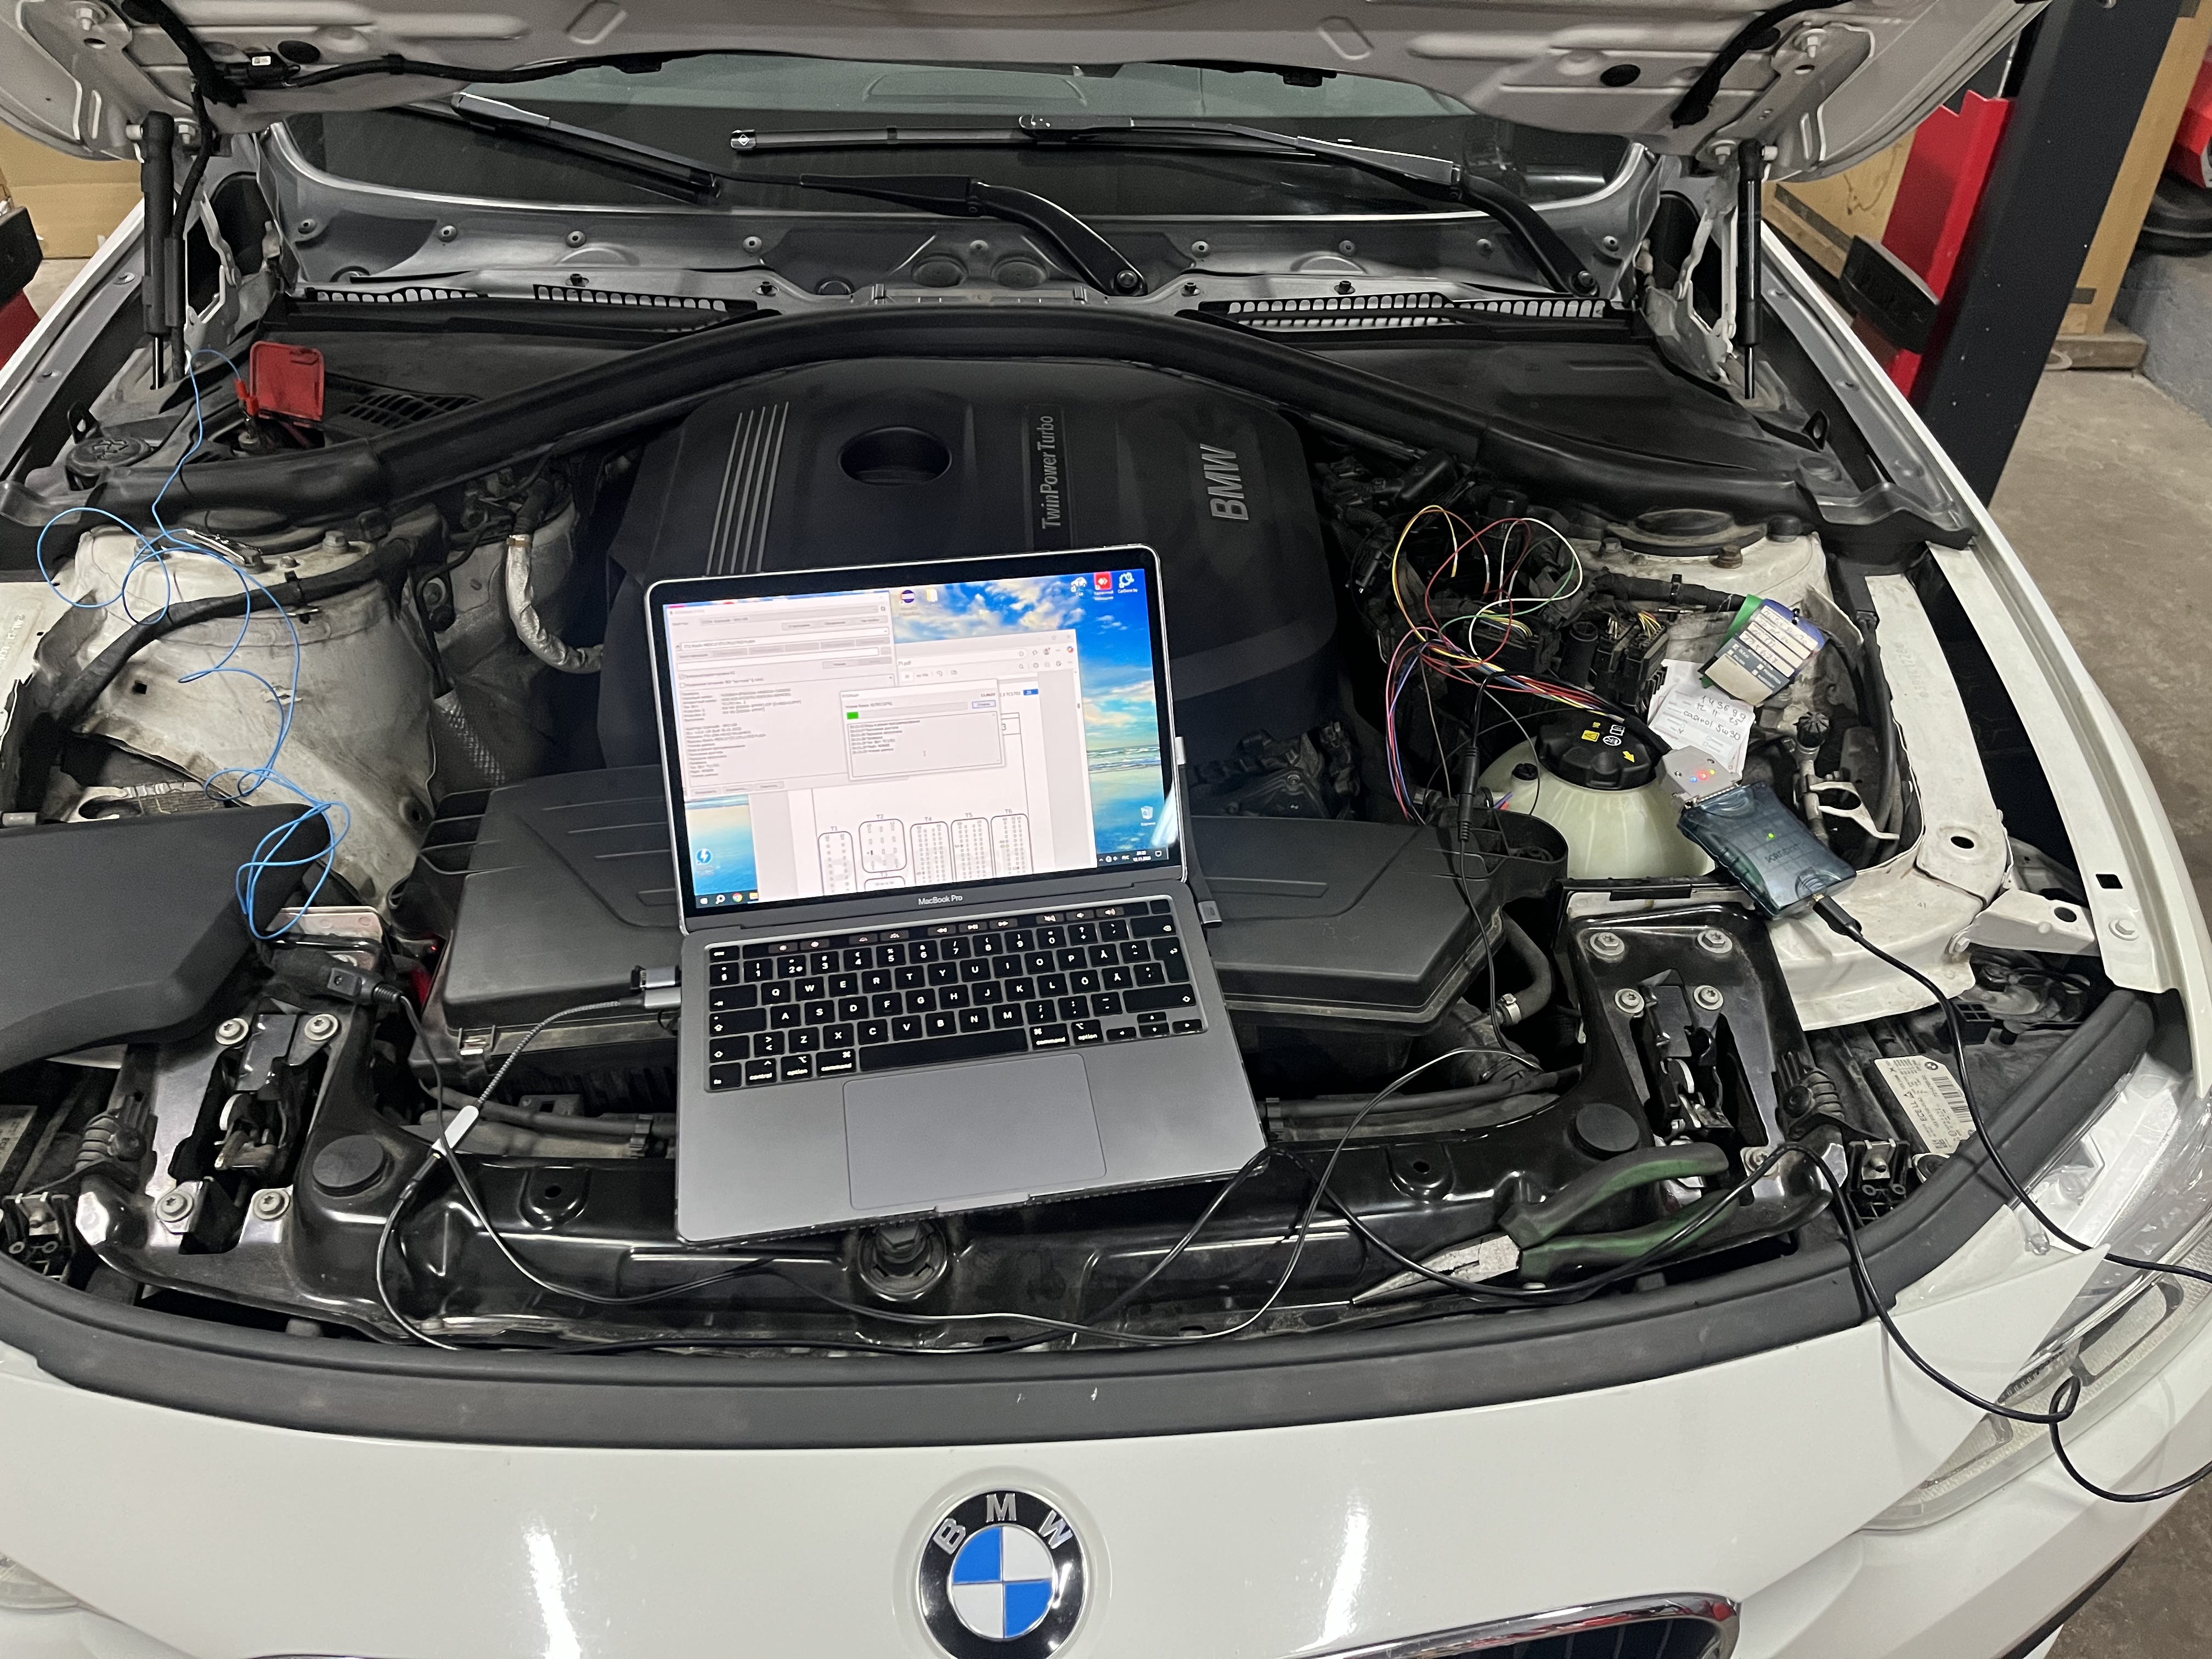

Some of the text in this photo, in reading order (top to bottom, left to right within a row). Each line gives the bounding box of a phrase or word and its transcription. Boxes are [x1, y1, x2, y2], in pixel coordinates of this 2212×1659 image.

[1037, 415, 1061, 529] TwinPower Turbo
[1200, 443, 1249, 520] BMW
[918, 894, 963, 905] MacBook Pro
[1036, 1037, 1065, 1045] command
[933, 1493, 1073, 1555] BMW
